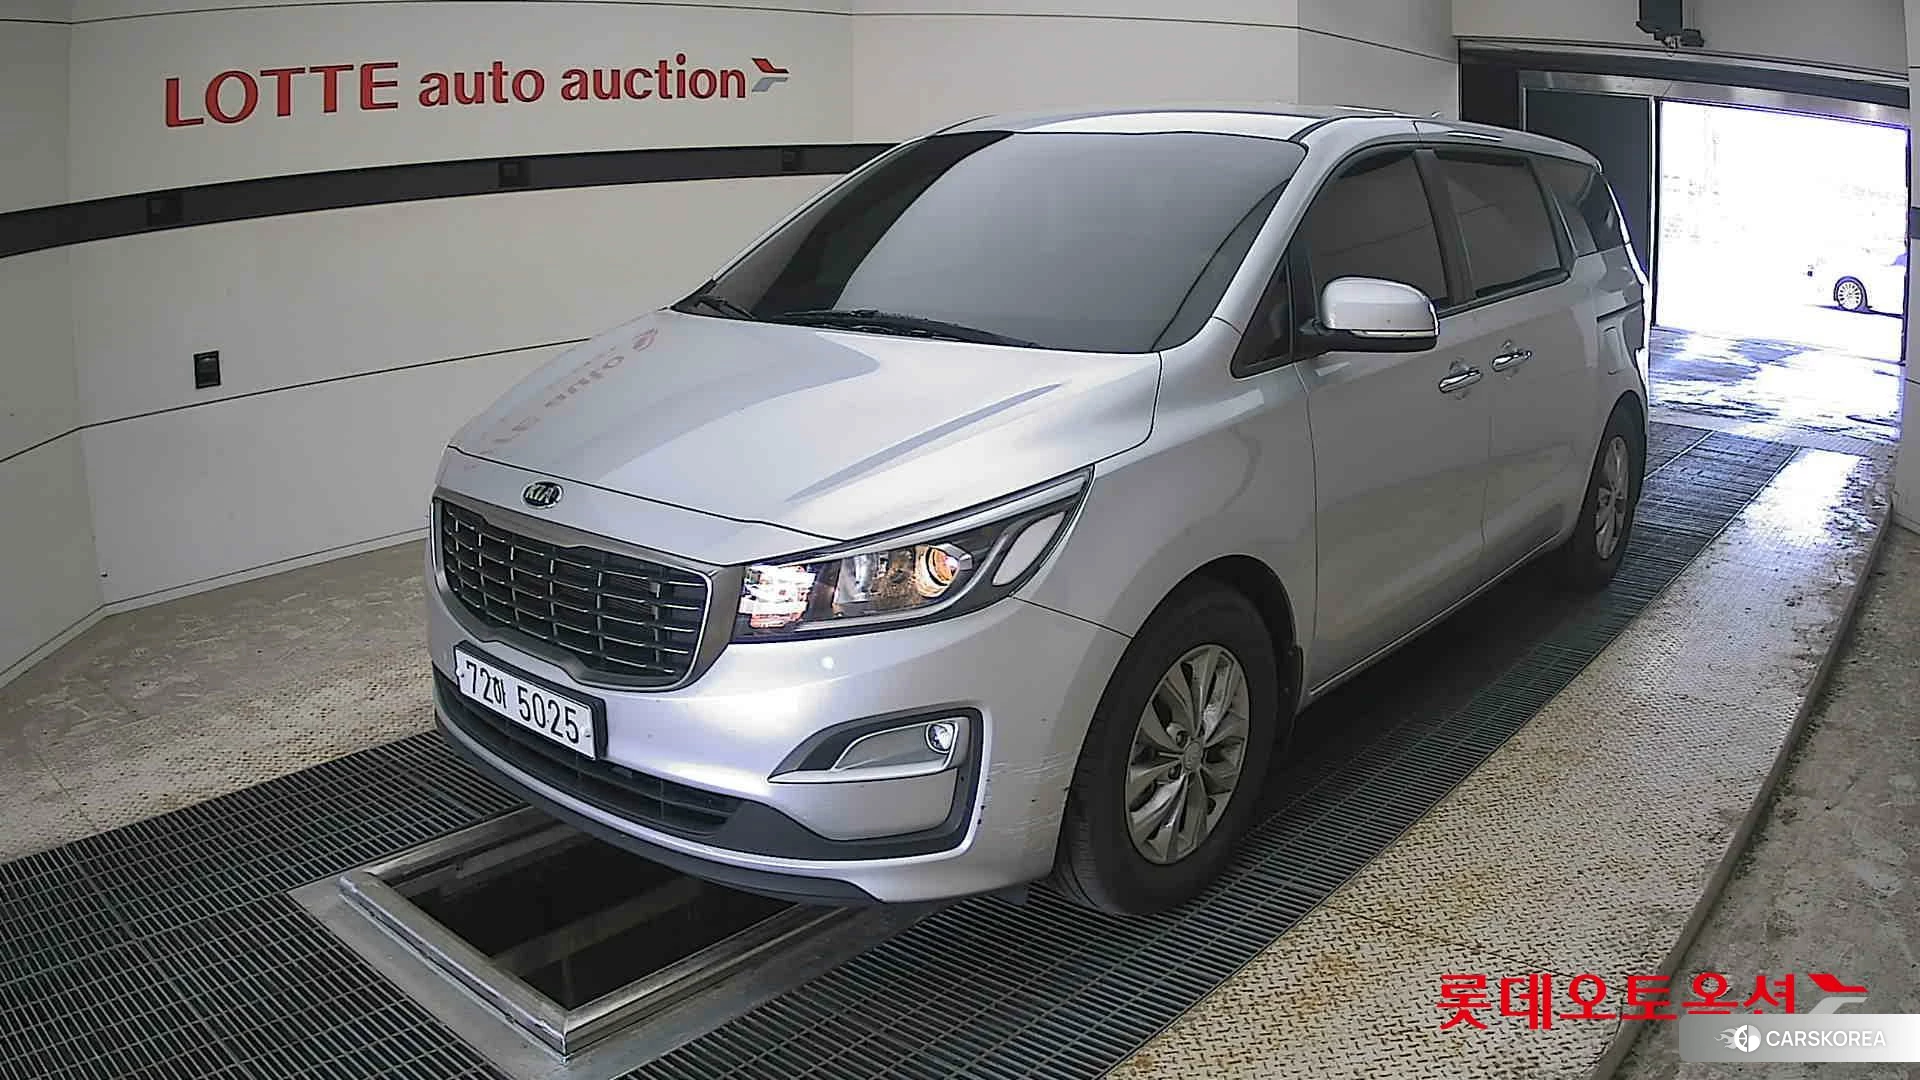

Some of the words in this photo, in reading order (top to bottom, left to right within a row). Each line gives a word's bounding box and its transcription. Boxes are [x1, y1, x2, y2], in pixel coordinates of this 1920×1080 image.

[165, 61, 399, 128] LOTTE
[417, 60, 546, 107] auto
[560, 53, 747, 101] auction
[524, 482, 556, 505] KIA
[516, 685, 579, 744] 5025
